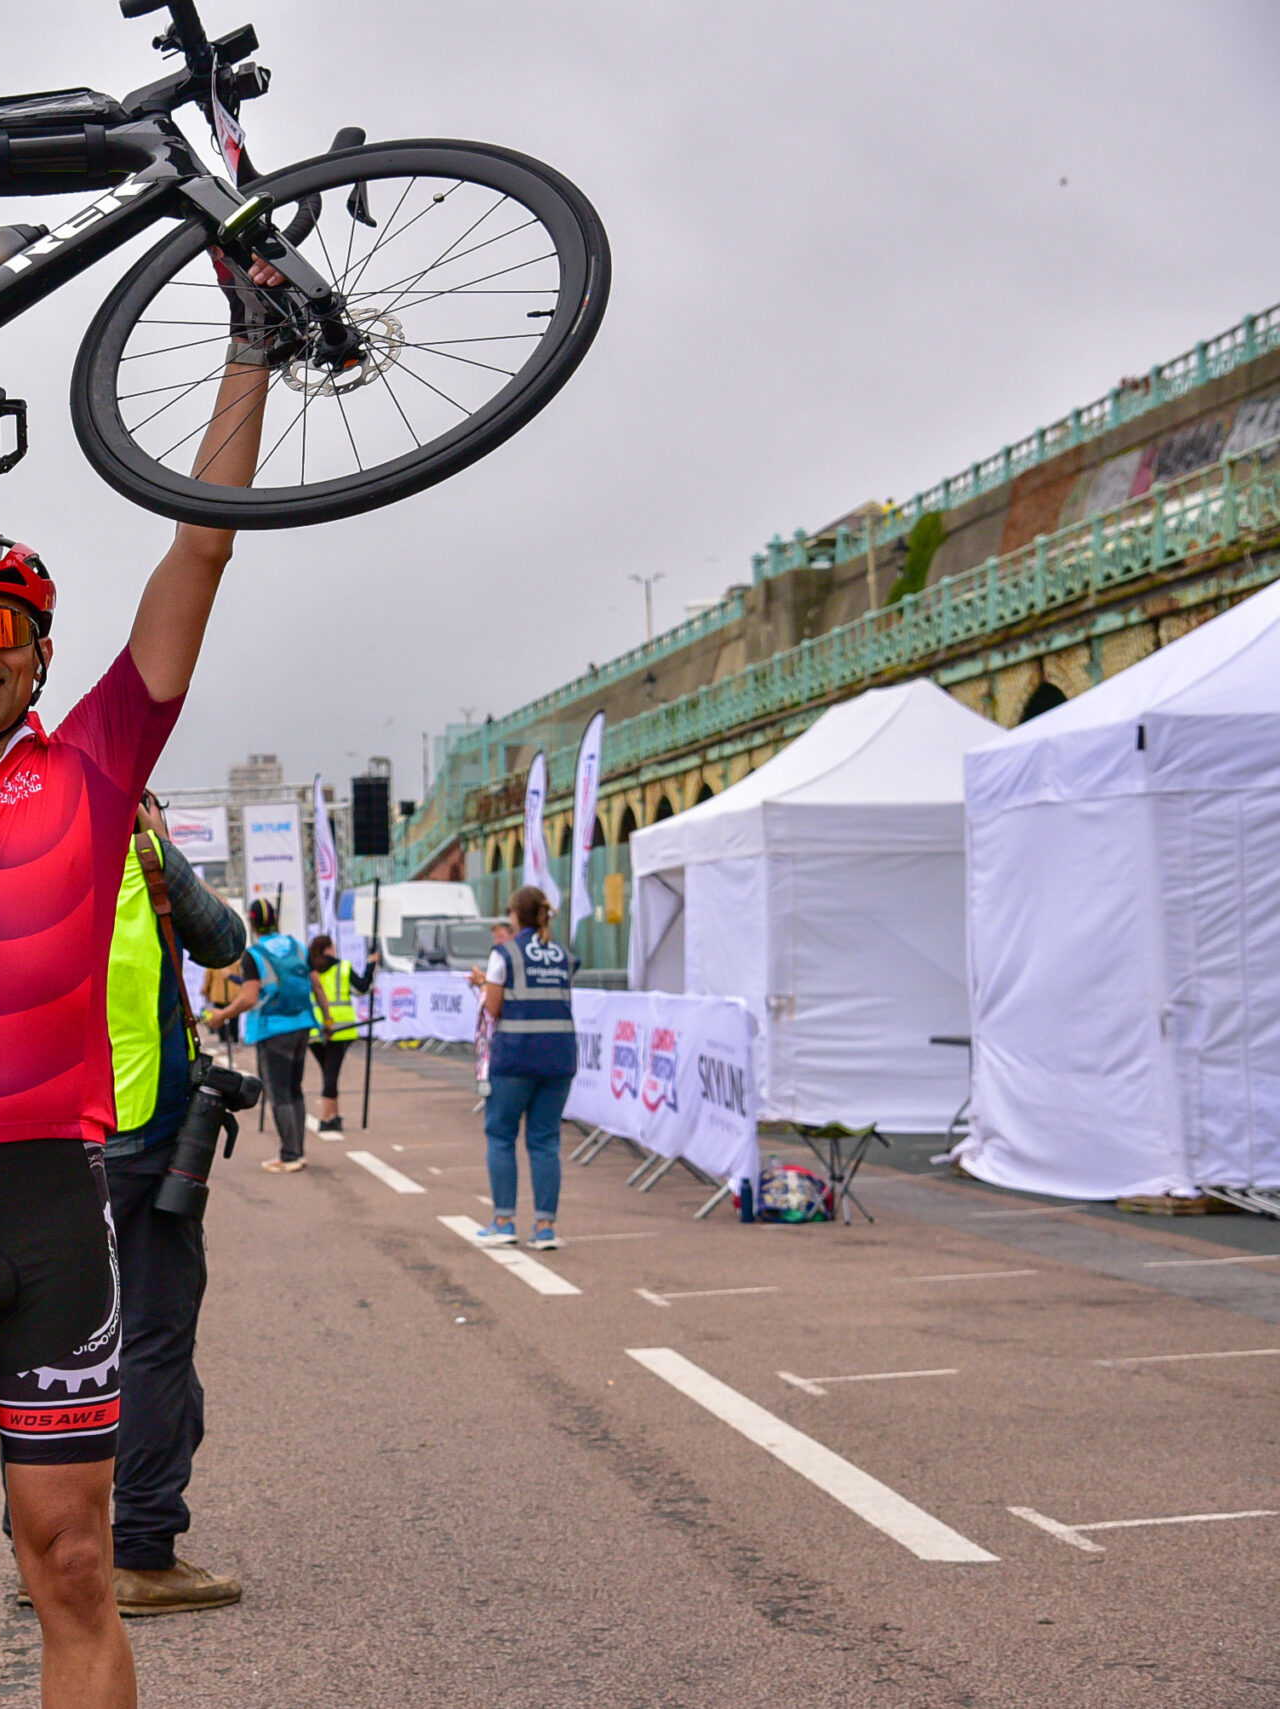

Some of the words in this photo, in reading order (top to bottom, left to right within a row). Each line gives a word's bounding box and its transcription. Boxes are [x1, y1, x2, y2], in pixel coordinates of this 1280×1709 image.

[430, 993, 462, 1014] SKYLINE
[698, 1055, 746, 1118] SKYLINE
[10, 1409, 106, 1427] WOSAWE
